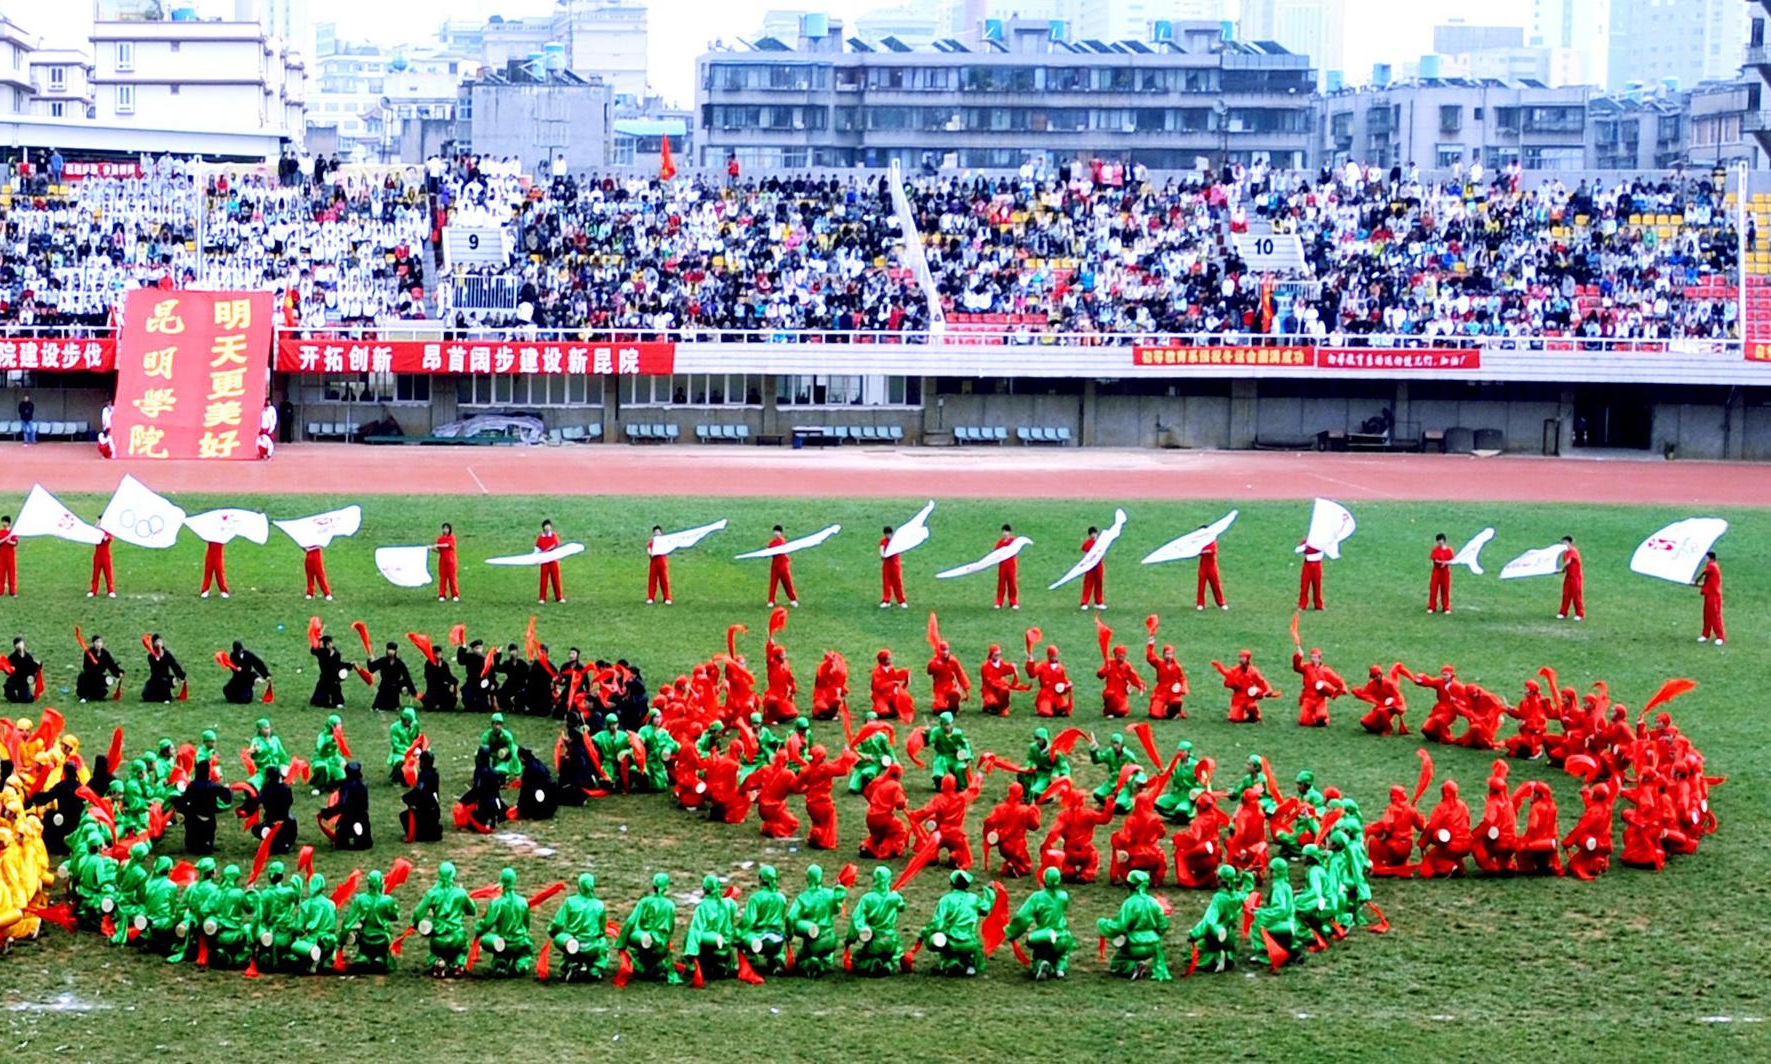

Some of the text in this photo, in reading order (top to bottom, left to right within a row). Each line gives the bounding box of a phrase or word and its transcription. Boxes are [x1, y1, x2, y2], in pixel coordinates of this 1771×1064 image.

[468, 233, 480, 250] 9
[1254, 238, 1274, 255] 10
[298, 344, 640, 374] 开拓创新 昂首阔步建设新昆院
[197, 298, 252, 459] 明天更美好
